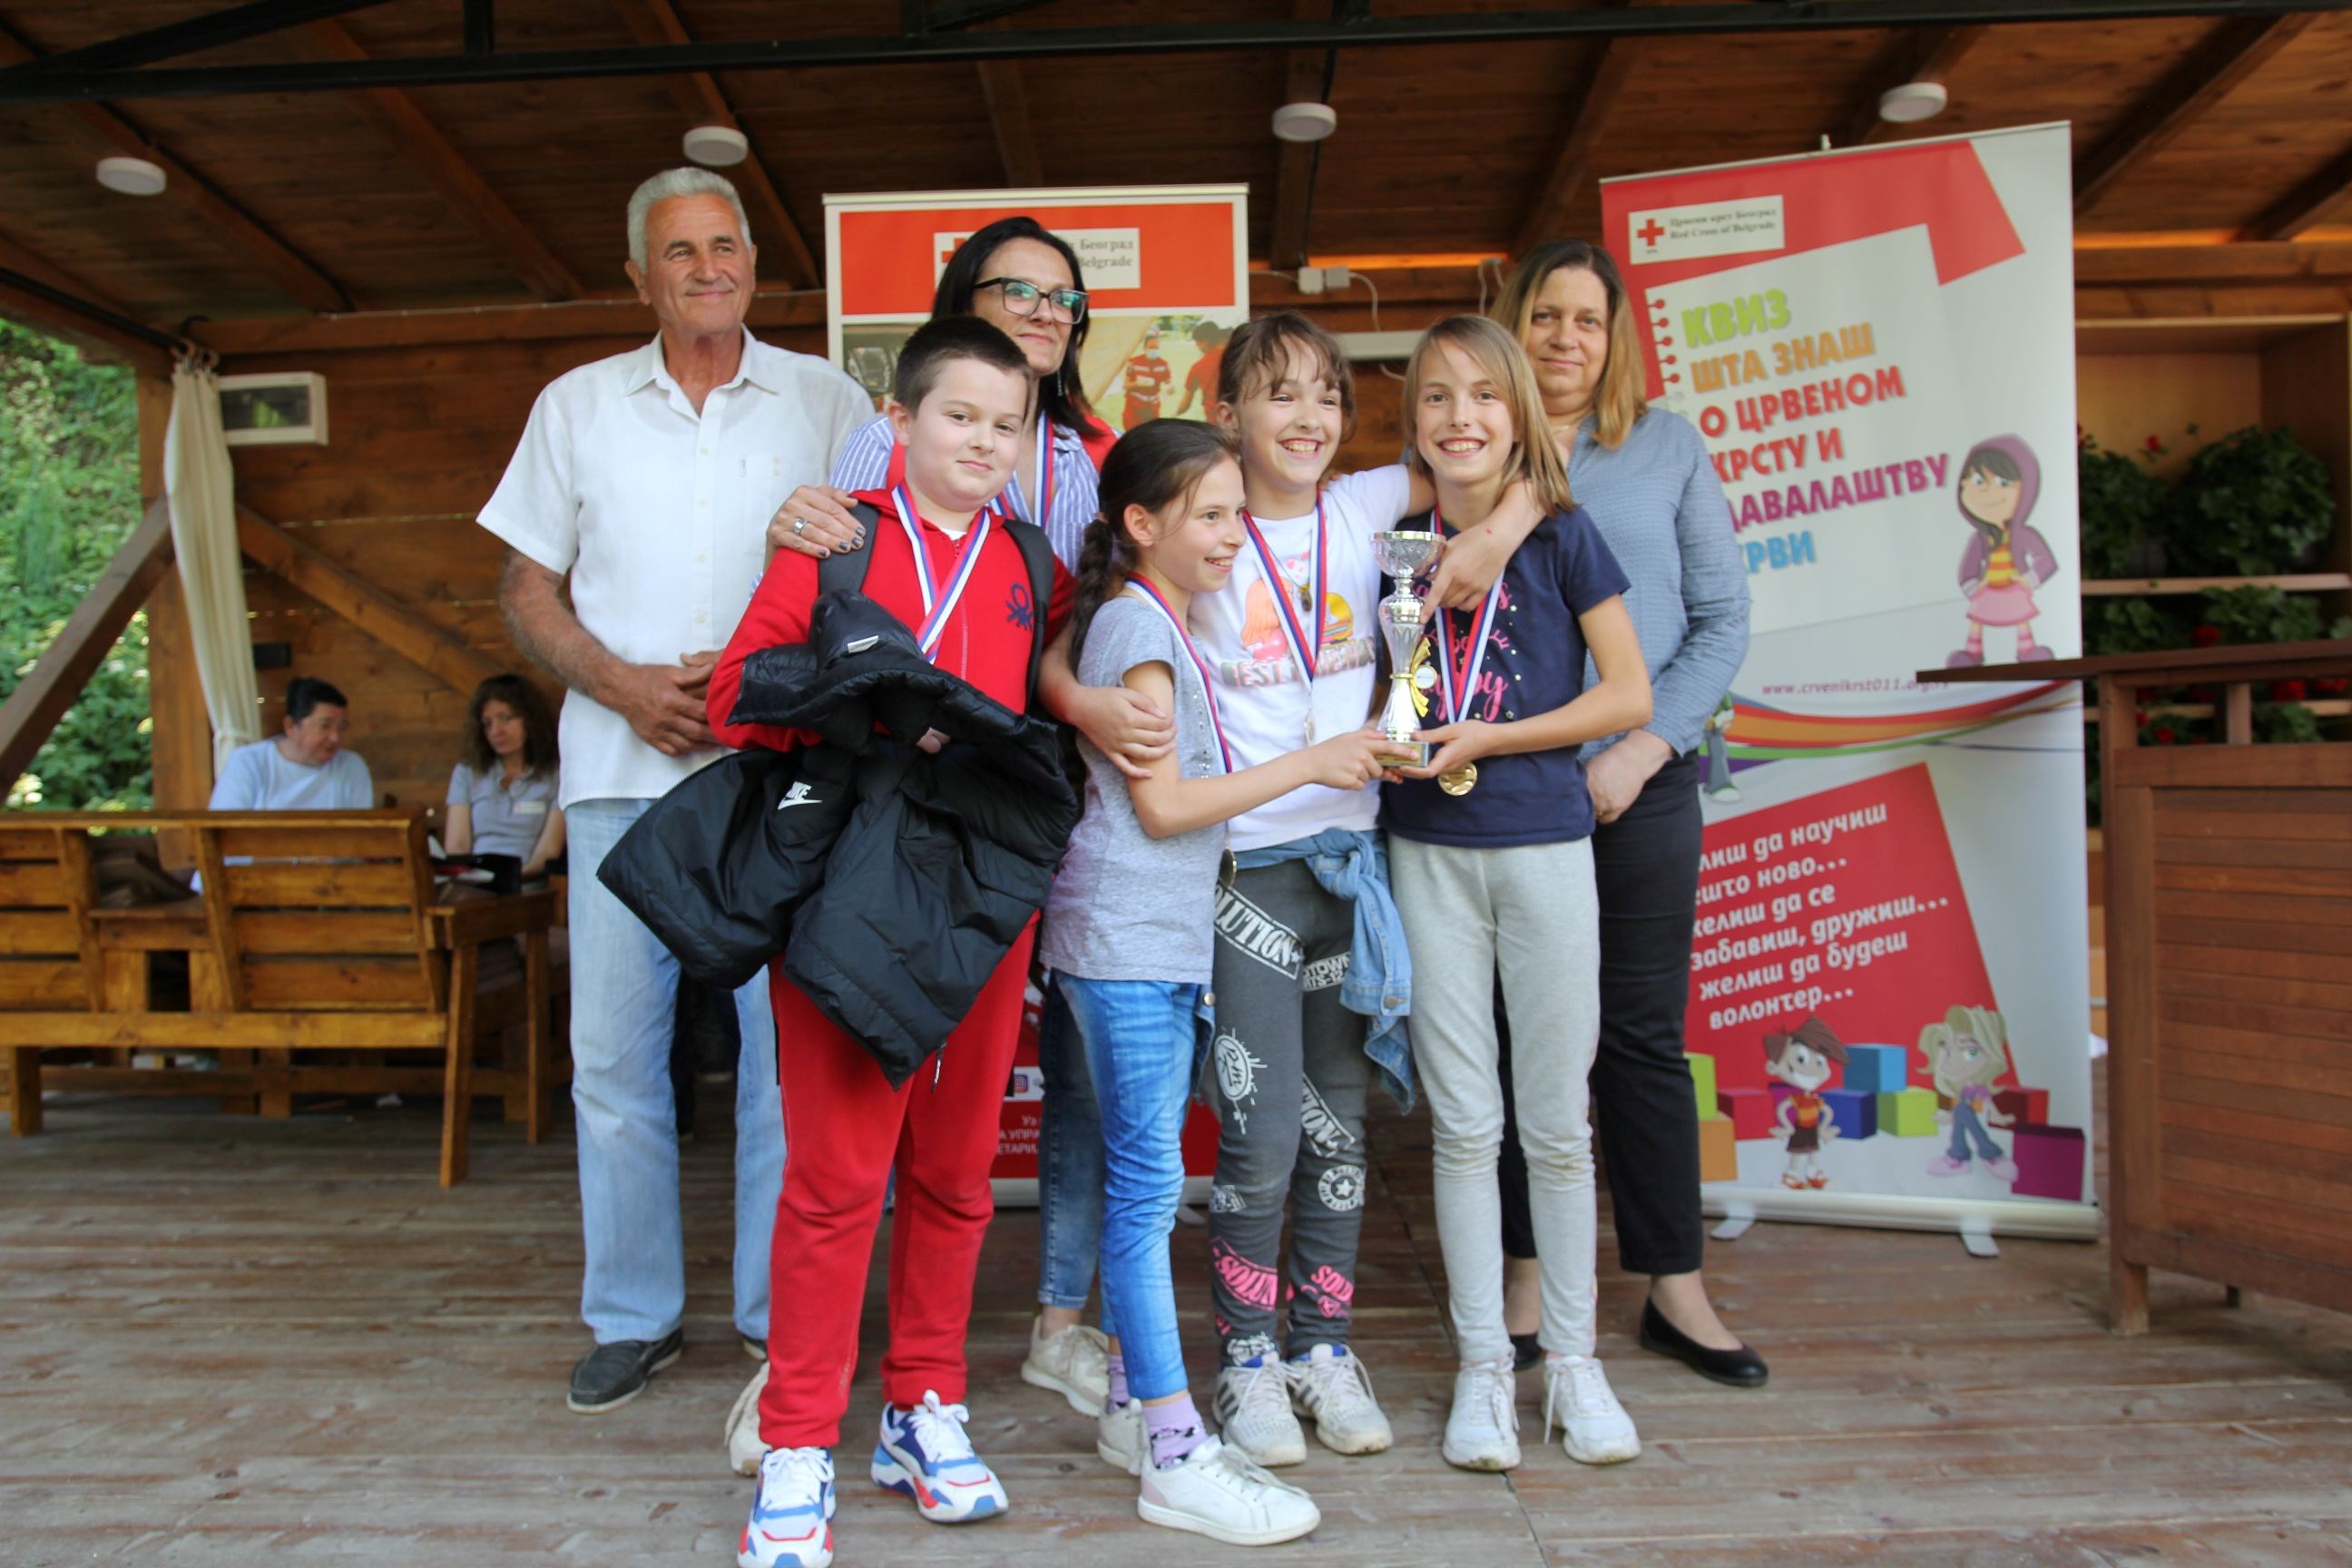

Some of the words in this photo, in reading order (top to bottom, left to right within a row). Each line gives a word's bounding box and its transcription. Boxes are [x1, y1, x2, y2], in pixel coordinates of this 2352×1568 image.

[1681, 288, 1791, 348] КВИЗ
[1690, 349, 1768, 394] ШТА
[1771, 322, 1876, 376] ЗНАШ
[1700, 406, 1728, 438] О
[1734, 366, 1906, 433] ЦРВЕНОМ
[1816, 427, 1845, 463] И
[1744, 531, 1816, 574] РВИ
[1699, 843, 1748, 873] лиш
[1753, 832, 1783, 862] да
[1790, 803, 1887, 846] научиш
[1695, 875, 1751, 906] што
[1757, 857, 1847, 889] ново...
[1771, 893, 1803, 923] да
[1808, 884, 1836, 907] се
[1690, 926, 1807, 971] забавиш,
[1810, 895, 1949, 946] дружиш...
[1699, 962, 1784, 1001] желиш
[1789, 953, 1820, 983] да
[1826, 930, 1908, 971] будеш
[1709, 985, 1854, 1031] волонтер...
